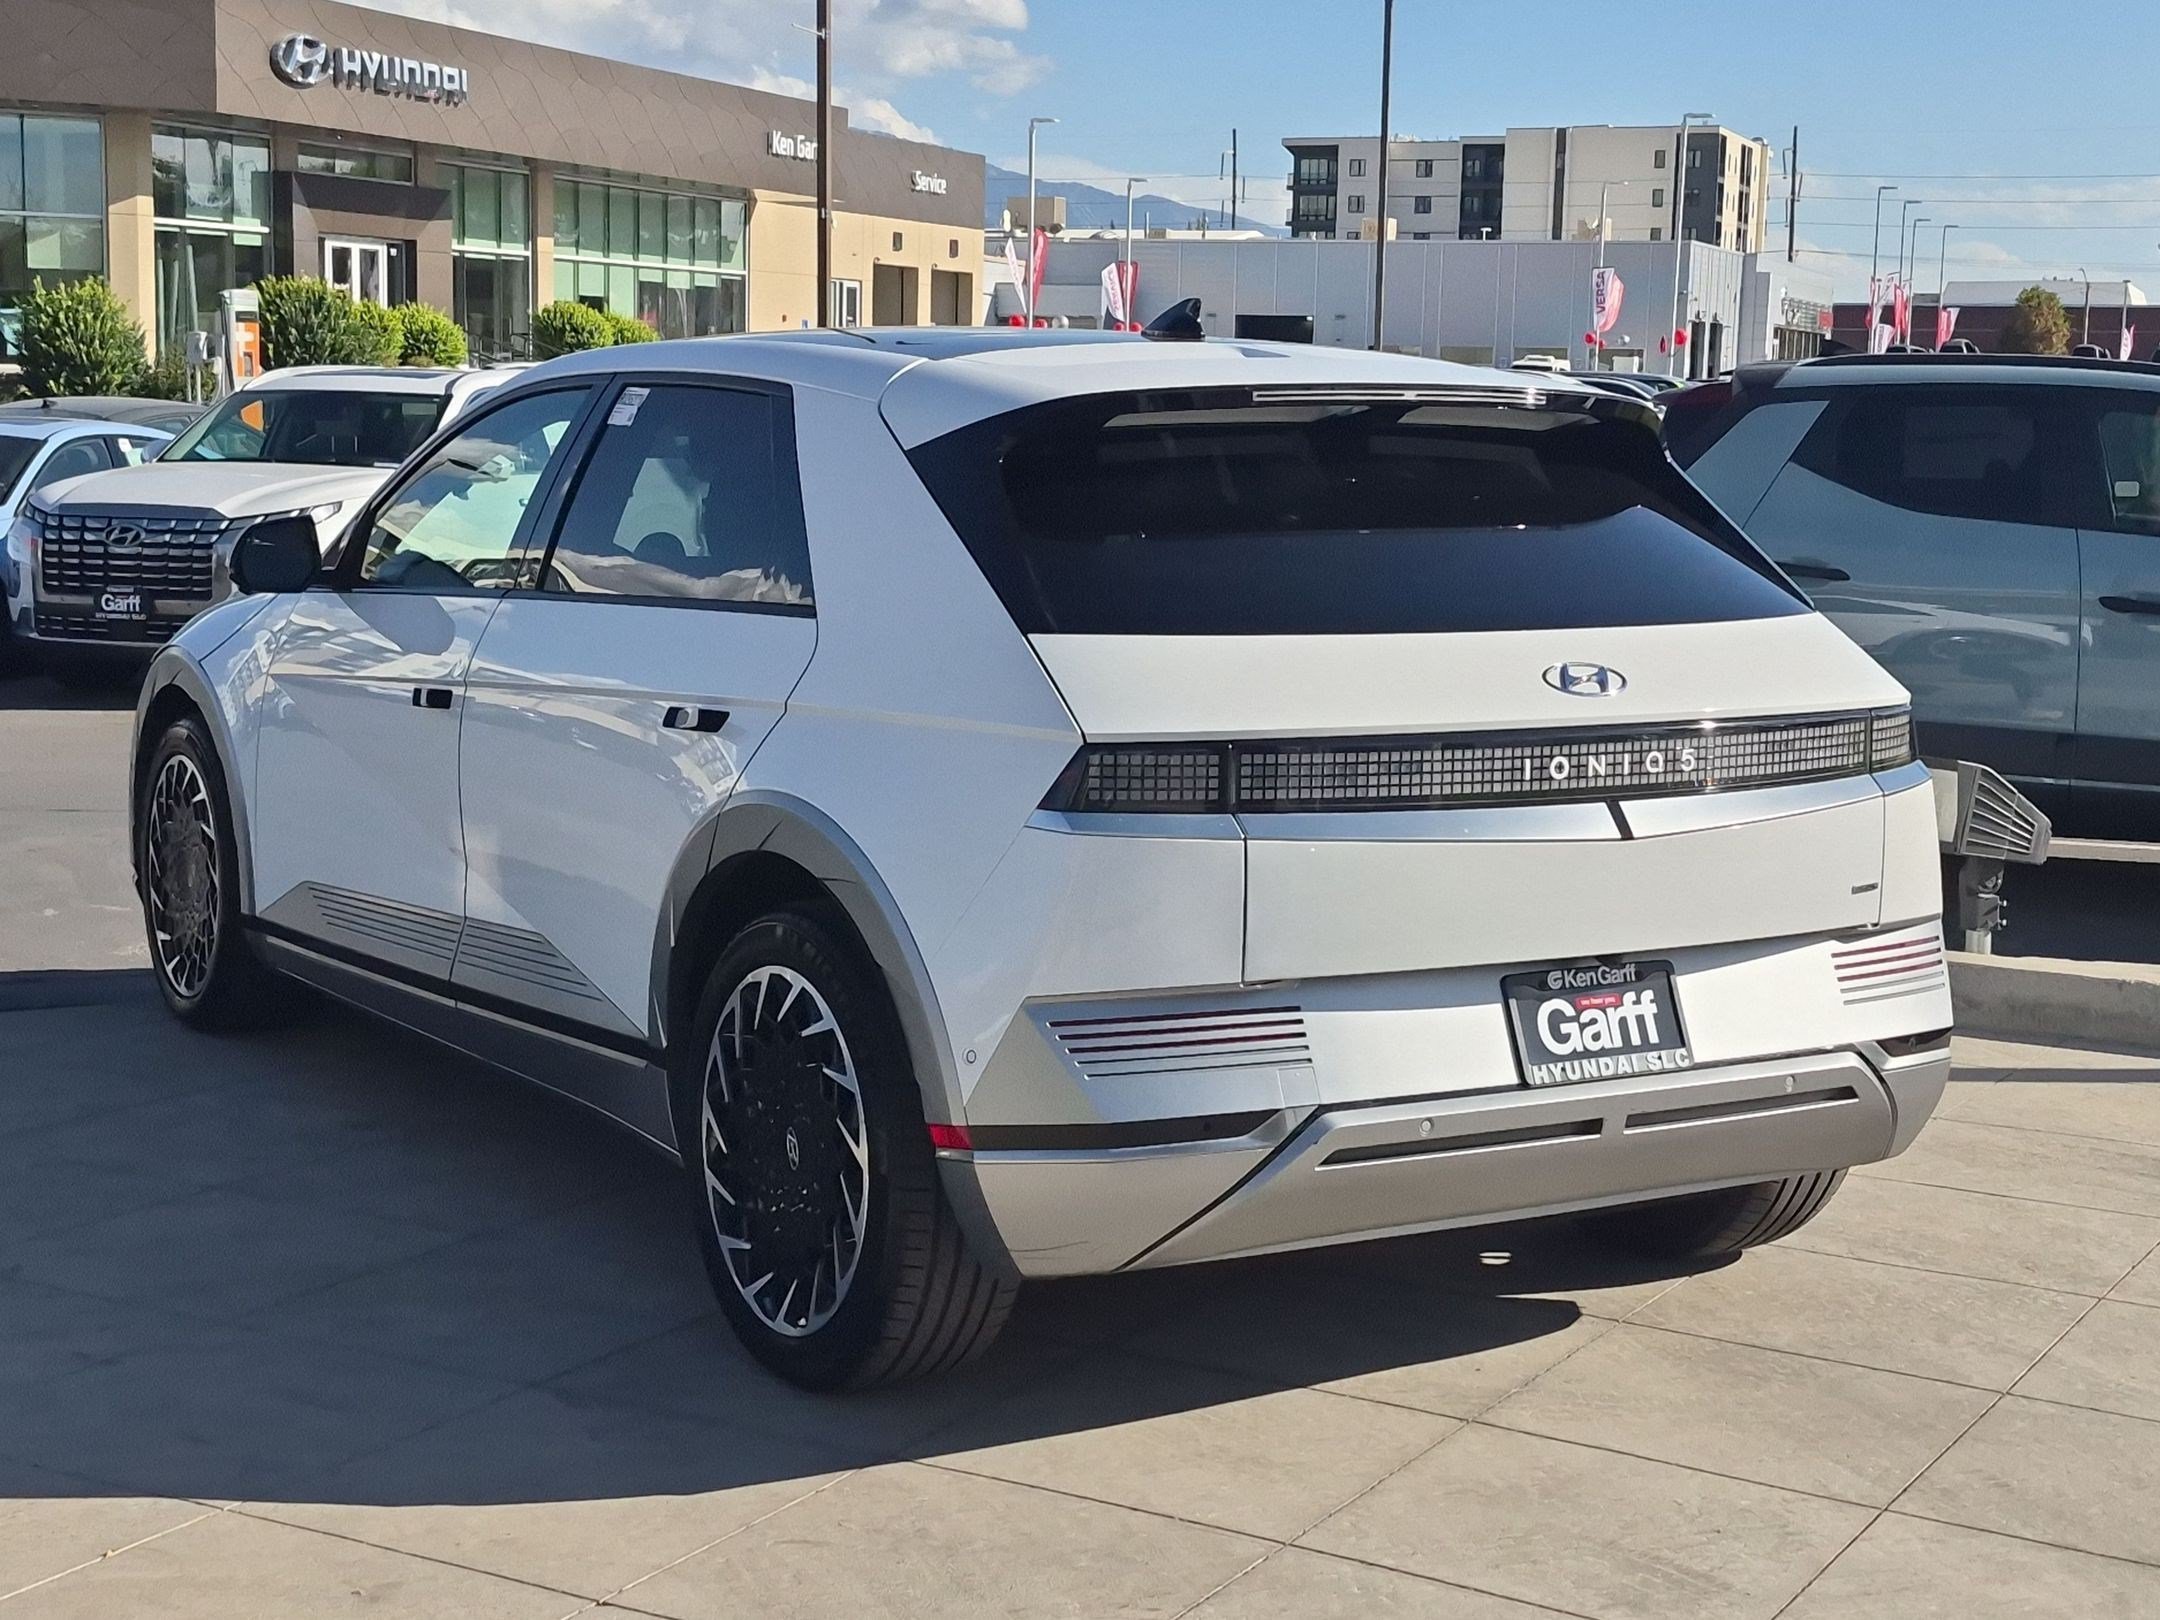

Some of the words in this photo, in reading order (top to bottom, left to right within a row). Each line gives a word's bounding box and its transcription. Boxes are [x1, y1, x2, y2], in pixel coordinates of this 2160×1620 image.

[341, 46, 468, 93] HYUNDAI
[772, 130, 794, 156] Ken
[796, 135, 817, 160] Gar
[915, 170, 947, 195] Service
[1595, 270, 1606, 314] VERSA
[101, 593, 141, 612] Garff
[1523, 751, 1664, 781] IONIQ
[1537, 989, 1660, 1056] Garff
[1532, 1055, 1640, 1085] HYUNDAI
[1646, 1049, 1690, 1073] SLC
